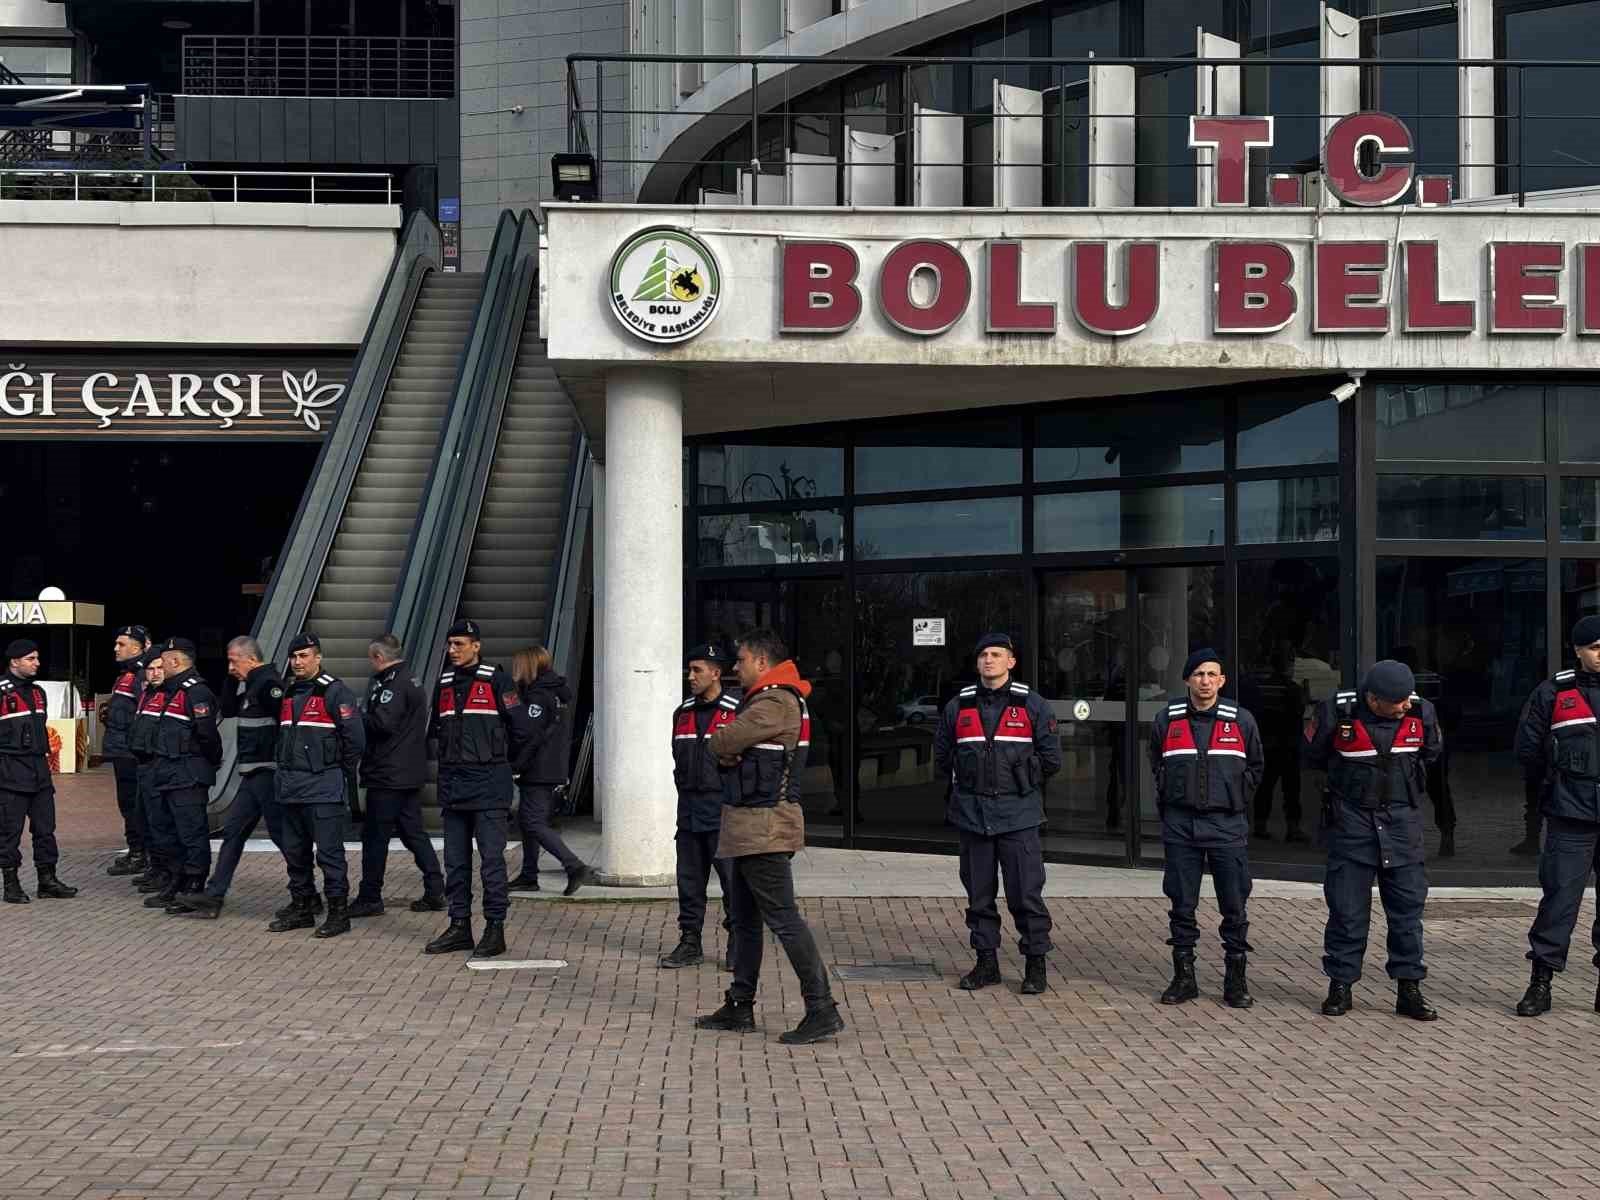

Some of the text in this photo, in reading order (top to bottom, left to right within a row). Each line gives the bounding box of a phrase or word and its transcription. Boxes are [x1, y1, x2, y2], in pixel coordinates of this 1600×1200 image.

[1189, 111, 1453, 207] T.C.
[615, 293, 715, 335] BELEDİYE BAŞKANLIĞI
[649, 305, 682, 315] BOLU
[779, 239, 1161, 336] BOLU
[82, 372, 264, 429] ÇARŞI
